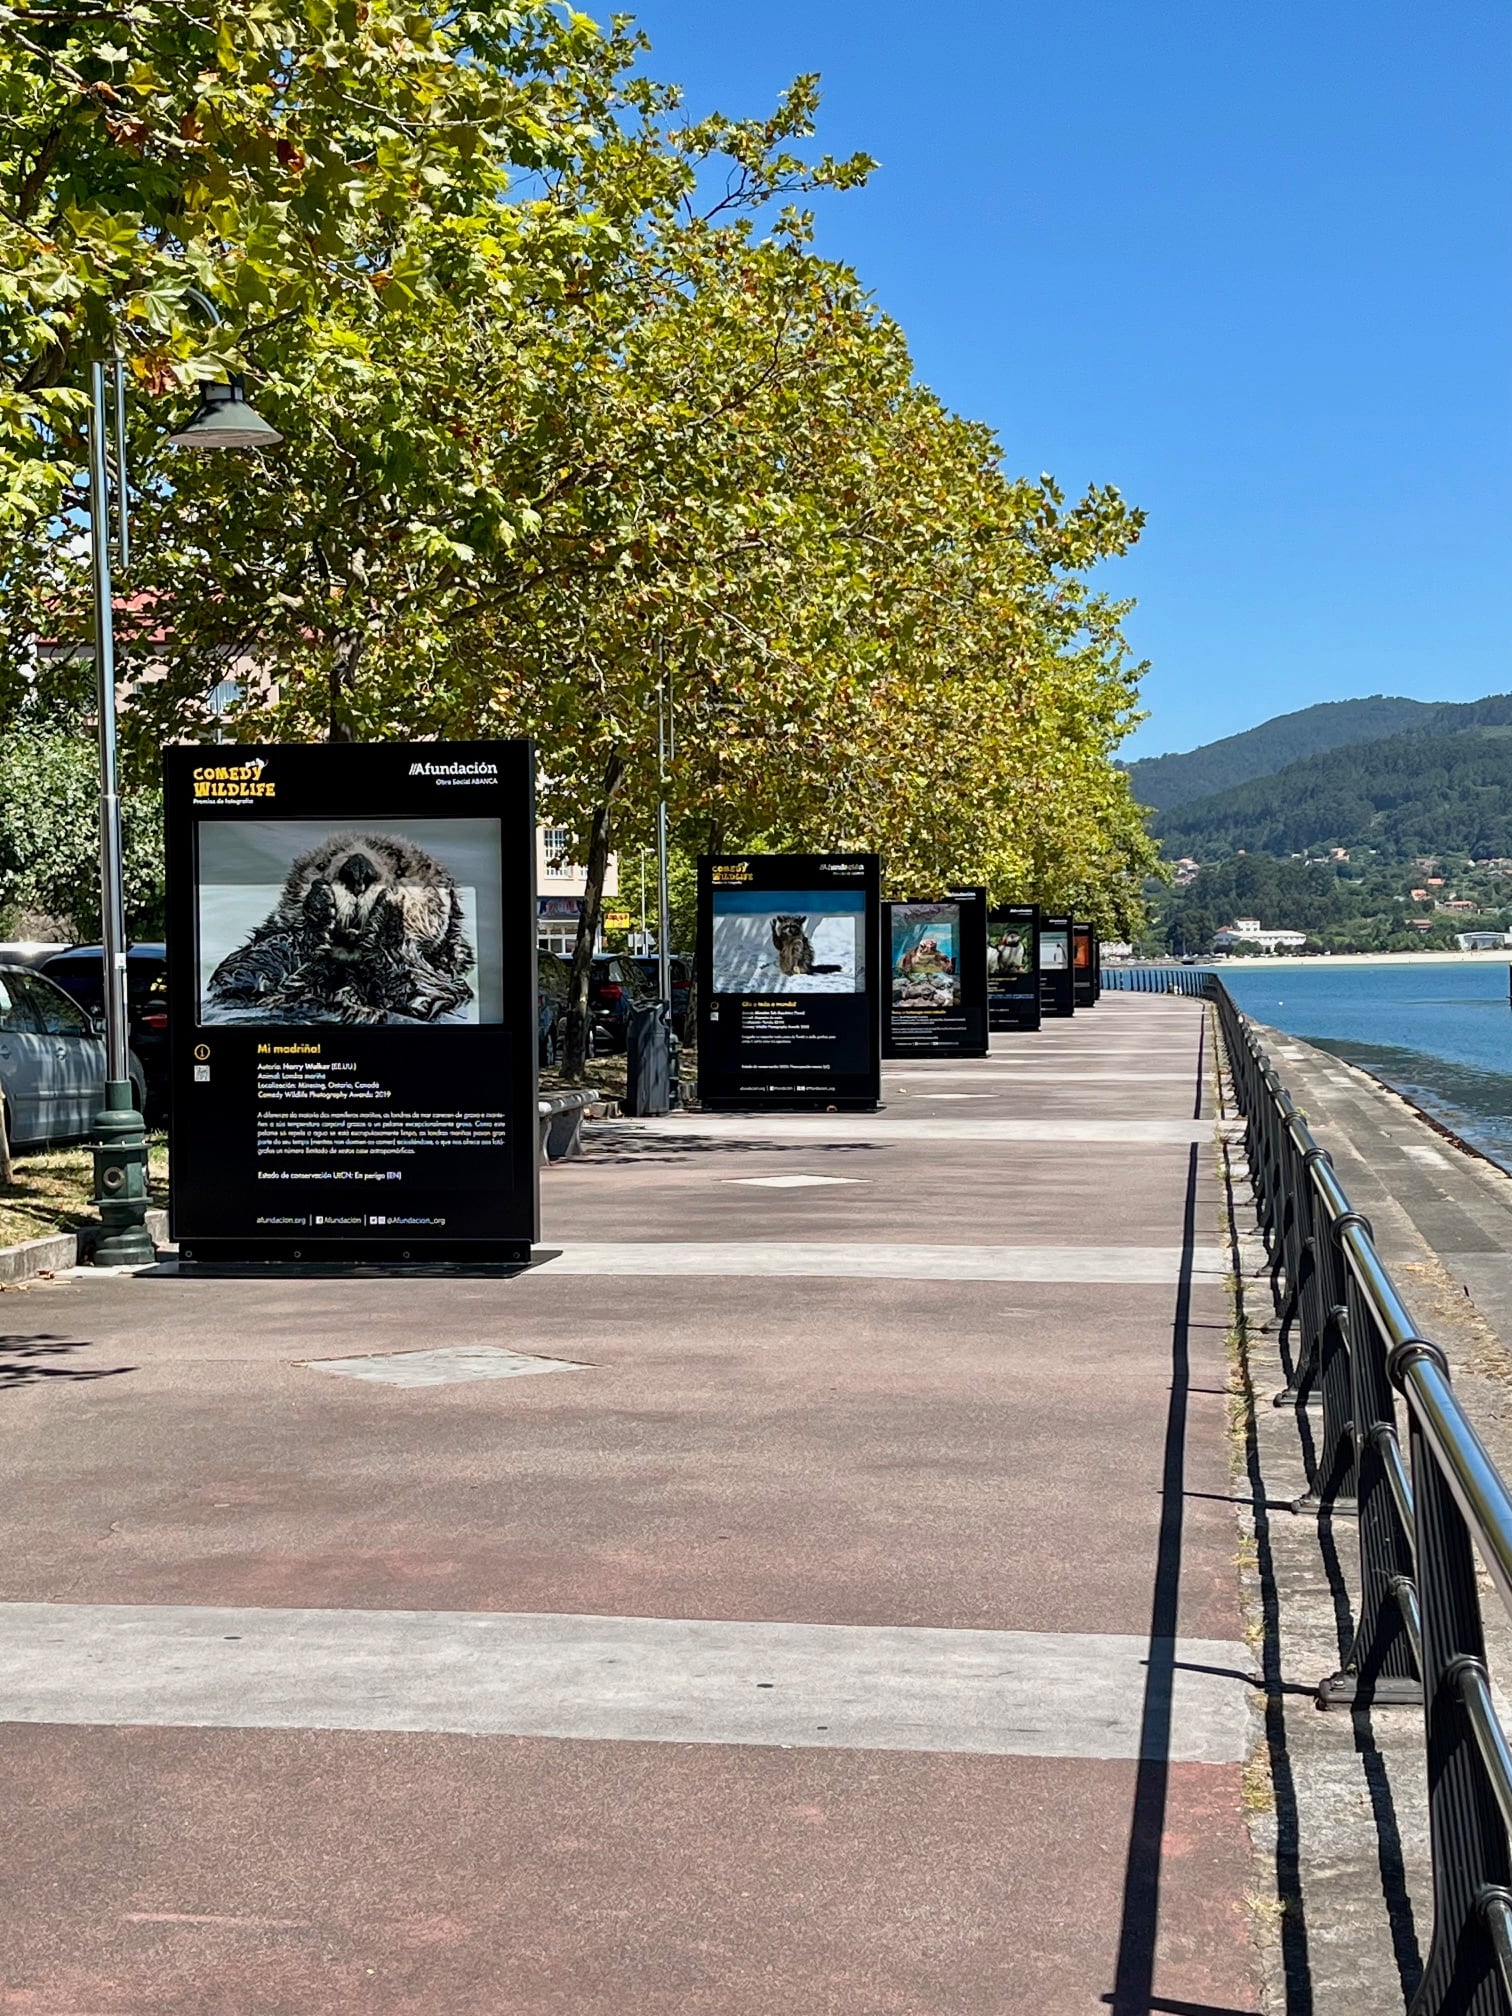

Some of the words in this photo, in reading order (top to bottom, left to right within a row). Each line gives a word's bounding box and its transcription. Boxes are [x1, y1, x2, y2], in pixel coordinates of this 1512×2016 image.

[193, 766, 262, 781] COMEDY
[193, 781, 276, 798] WILDLIFE
[258, 1043, 271, 1054] Mi
[283, 1063, 304, 1071] Harry
[305, 1062, 330, 1070] Walker
[258, 1091, 283, 1099] Comedy
[285, 1090, 308, 1098] Wildlife
[309, 1091, 347, 1099] Photography
[349, 1090, 373, 1098] Awards
[258, 1171, 279, 1179] Estado
[281, 1171, 289, 1179] de
